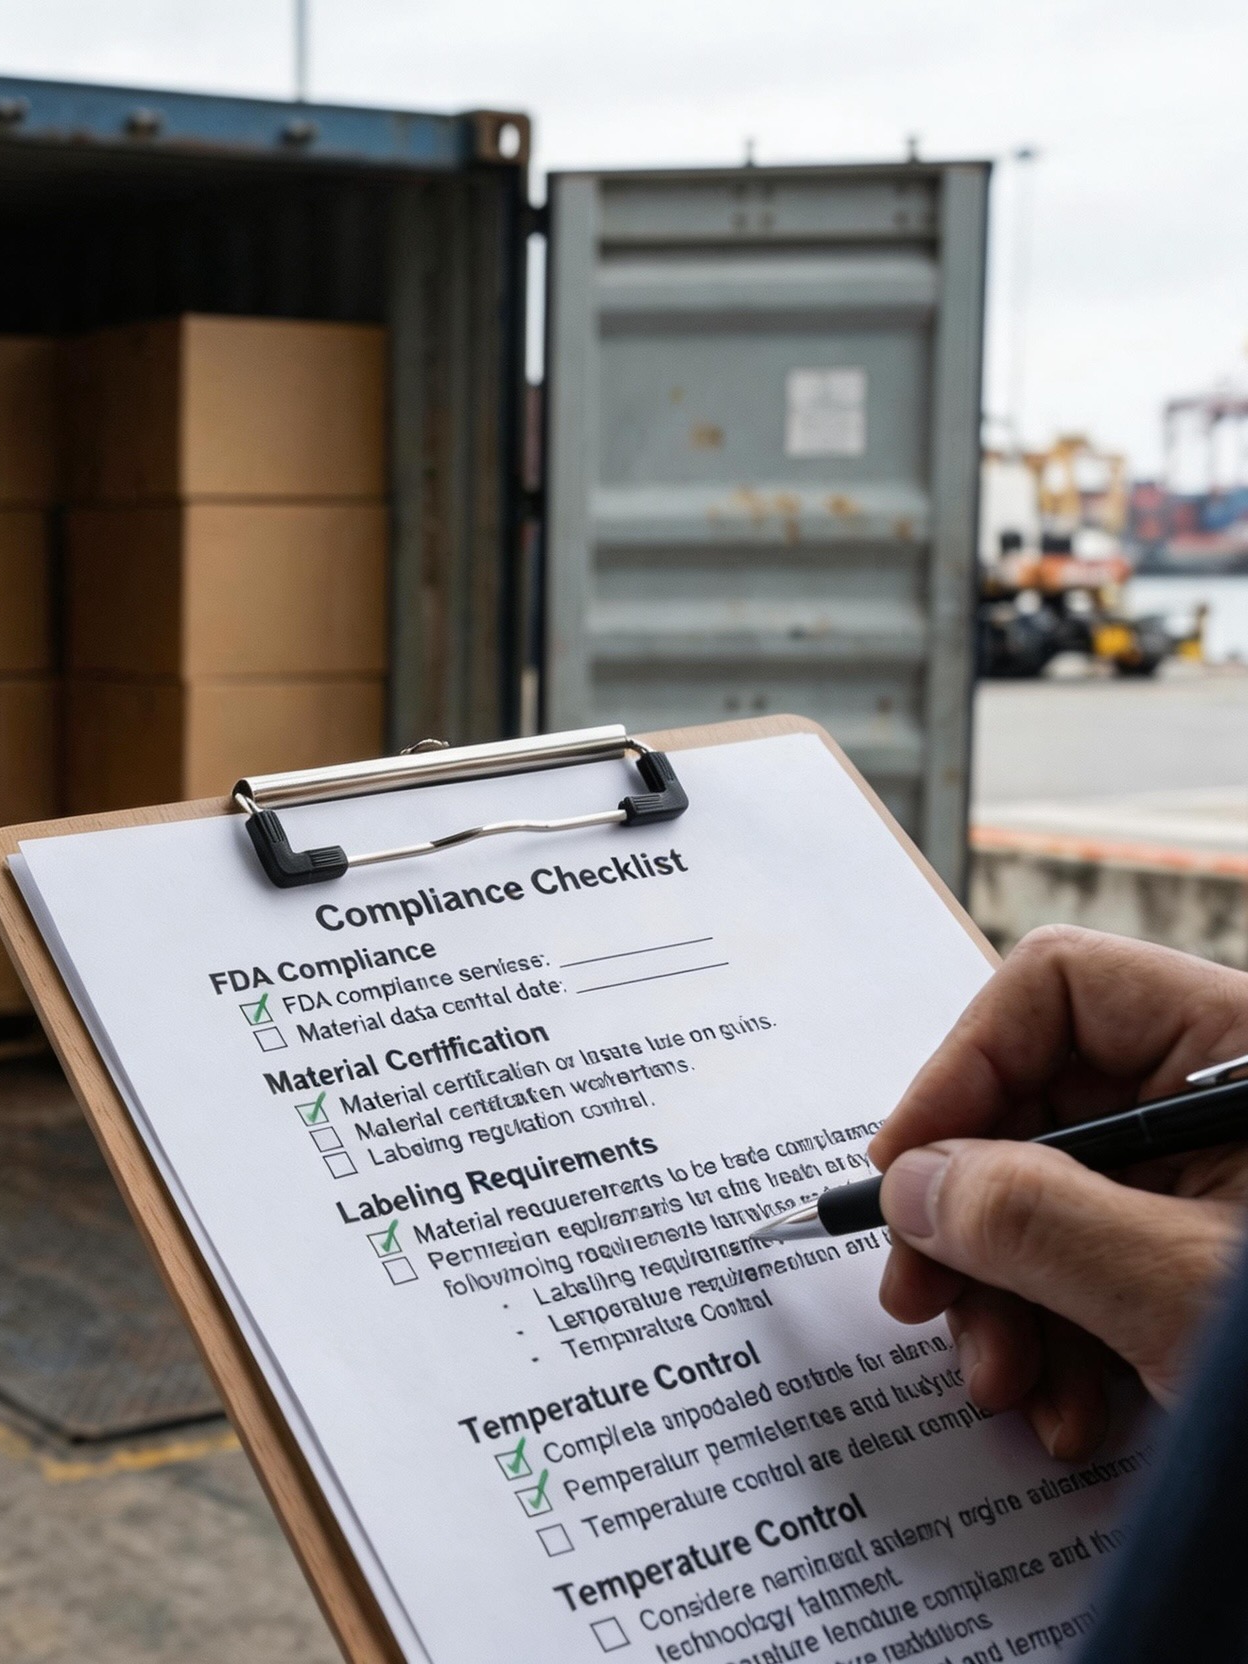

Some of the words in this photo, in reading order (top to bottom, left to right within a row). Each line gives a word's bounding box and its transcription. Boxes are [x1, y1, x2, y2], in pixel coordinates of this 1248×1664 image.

[315, 881, 524, 931] Compliance
[531, 849, 688, 894] Checklist
[208, 967, 274, 995] FDA
[277, 943, 436, 982] Compliance
[283, 992, 332, 1014] FDA
[296, 1012, 386, 1043] Material
[262, 1054, 380, 1095] Material
[339, 1082, 428, 1115] Material
[689, 1026, 716, 1043] on
[336, 1181, 464, 1224] Labeling
[465, 1136, 658, 1194] Requirements
[413, 1208, 502, 1244] Material
[458, 1378, 650, 1444] Temperature
[654, 1340, 761, 1390] Control
[553, 1535, 752, 1612] Temperature
[755, 1493, 867, 1547] Control
